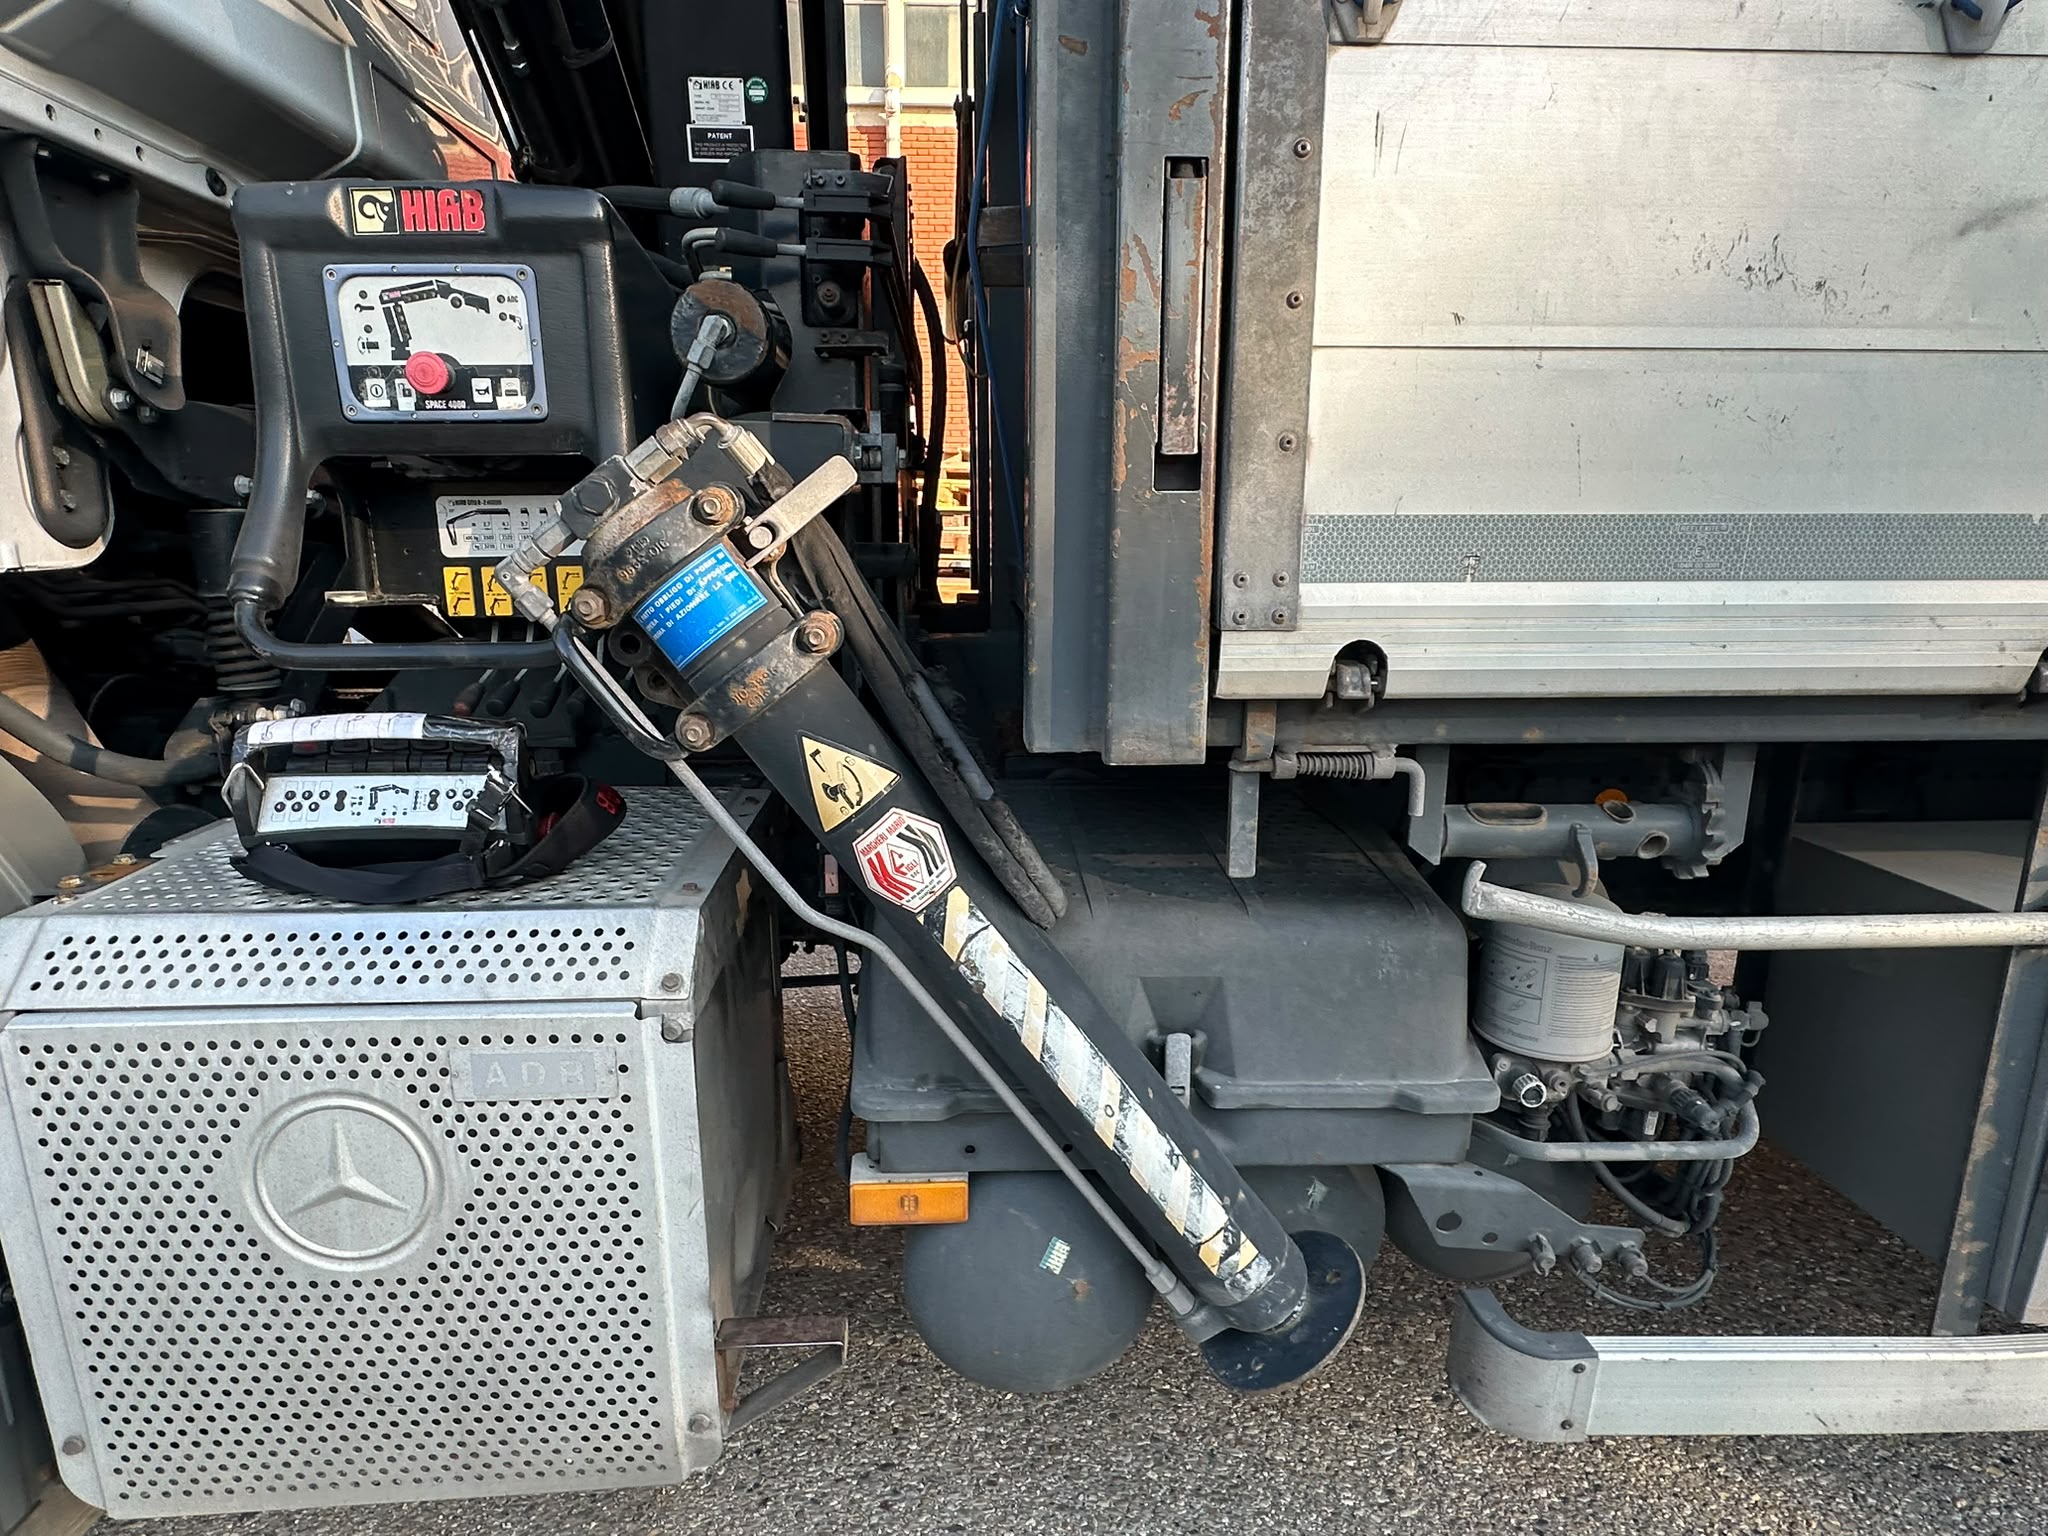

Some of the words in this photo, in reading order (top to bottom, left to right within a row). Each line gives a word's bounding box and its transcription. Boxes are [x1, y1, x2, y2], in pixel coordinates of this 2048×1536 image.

[703, 80, 720, 90] HIAB
[707, 132, 733, 140] PATENT
[401, 189, 486, 232] HIAB
[424, 400, 447, 409] SPACE
[448, 400, 466, 409] 4000
[654, 582, 684, 608] OBBLIGO
[683, 574, 695, 584] DI
[712, 582, 724, 592] LA
[664, 596, 684, 614] PIEDI
[686, 585, 696, 596] DI
[886, 815, 907, 837] MARIO
